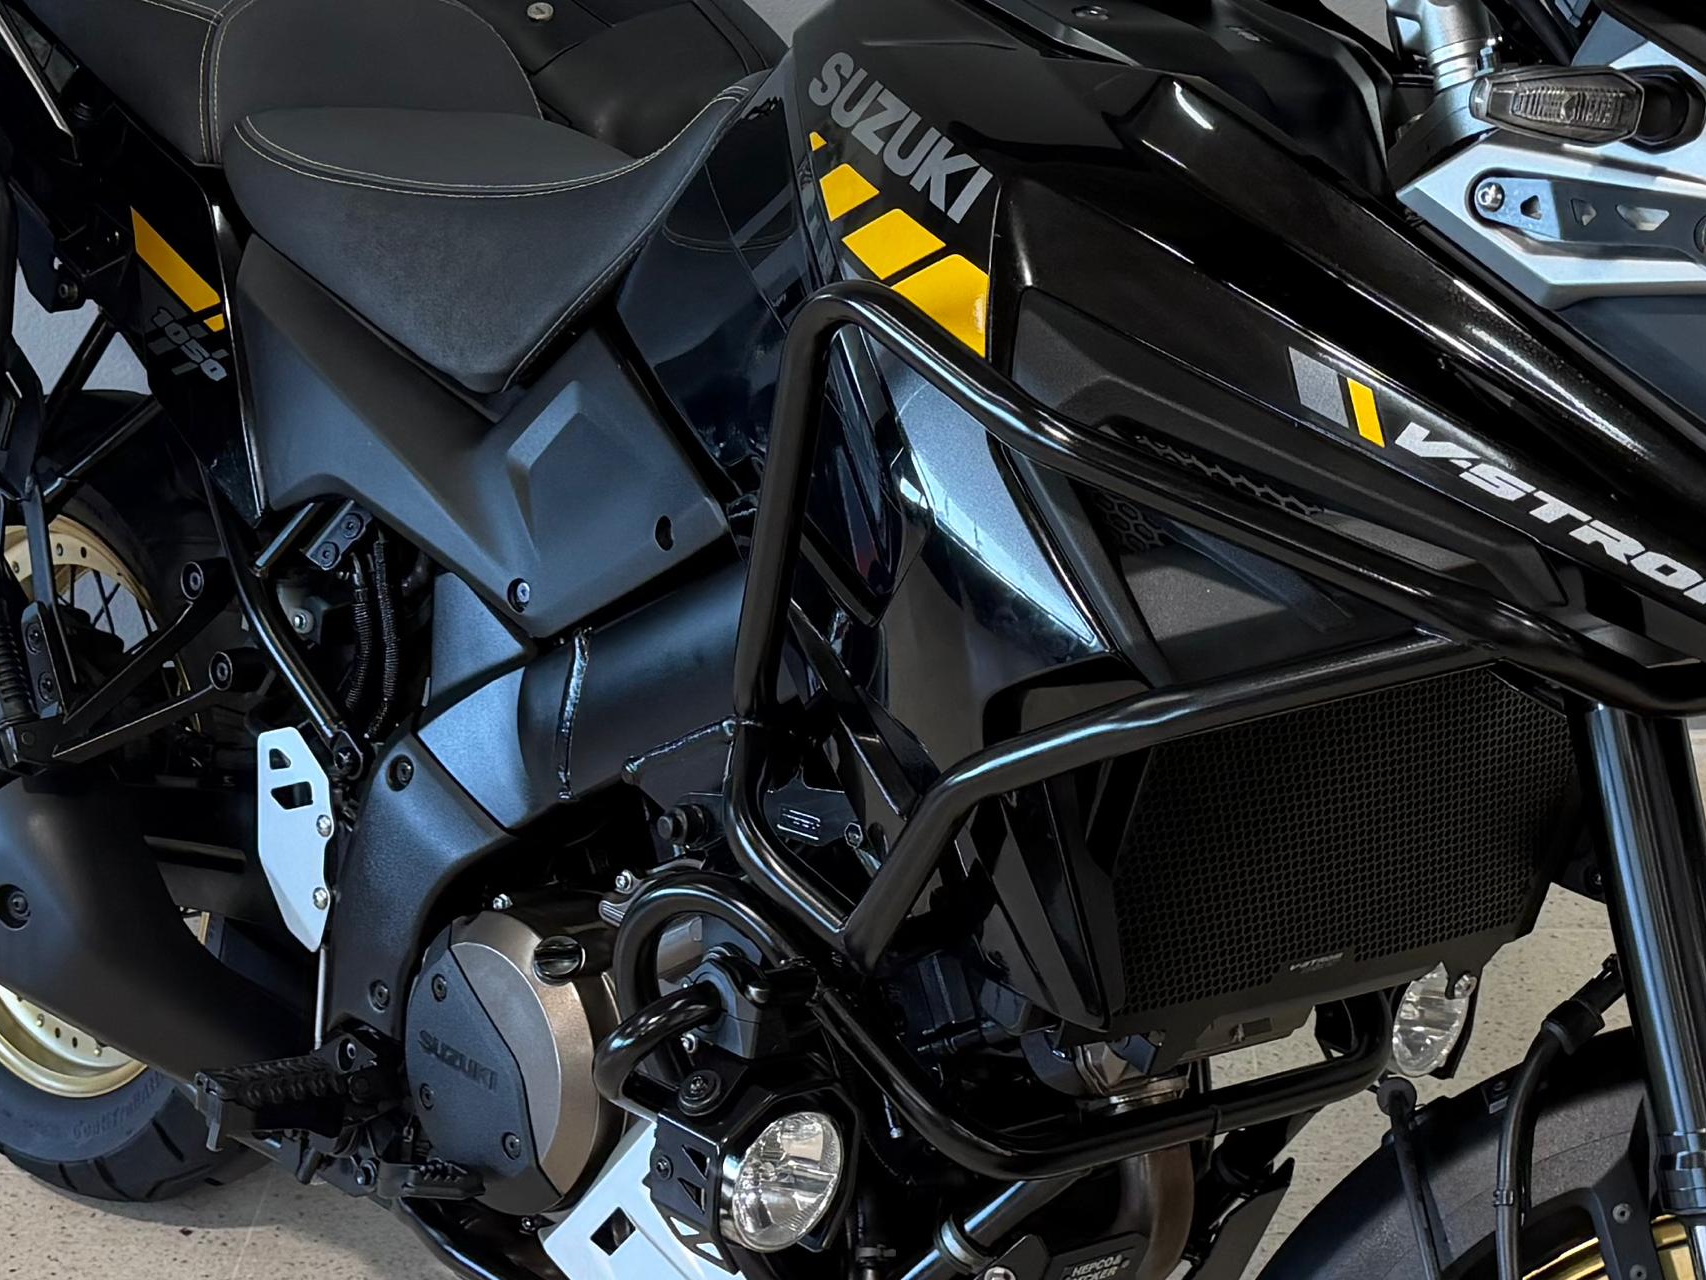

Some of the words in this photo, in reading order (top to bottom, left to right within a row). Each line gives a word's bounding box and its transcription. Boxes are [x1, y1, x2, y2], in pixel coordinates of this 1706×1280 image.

[808, 51, 994, 224] SUZUKI
[152, 307, 228, 382] 1050
[417, 1029, 498, 1092] SUZUKI
